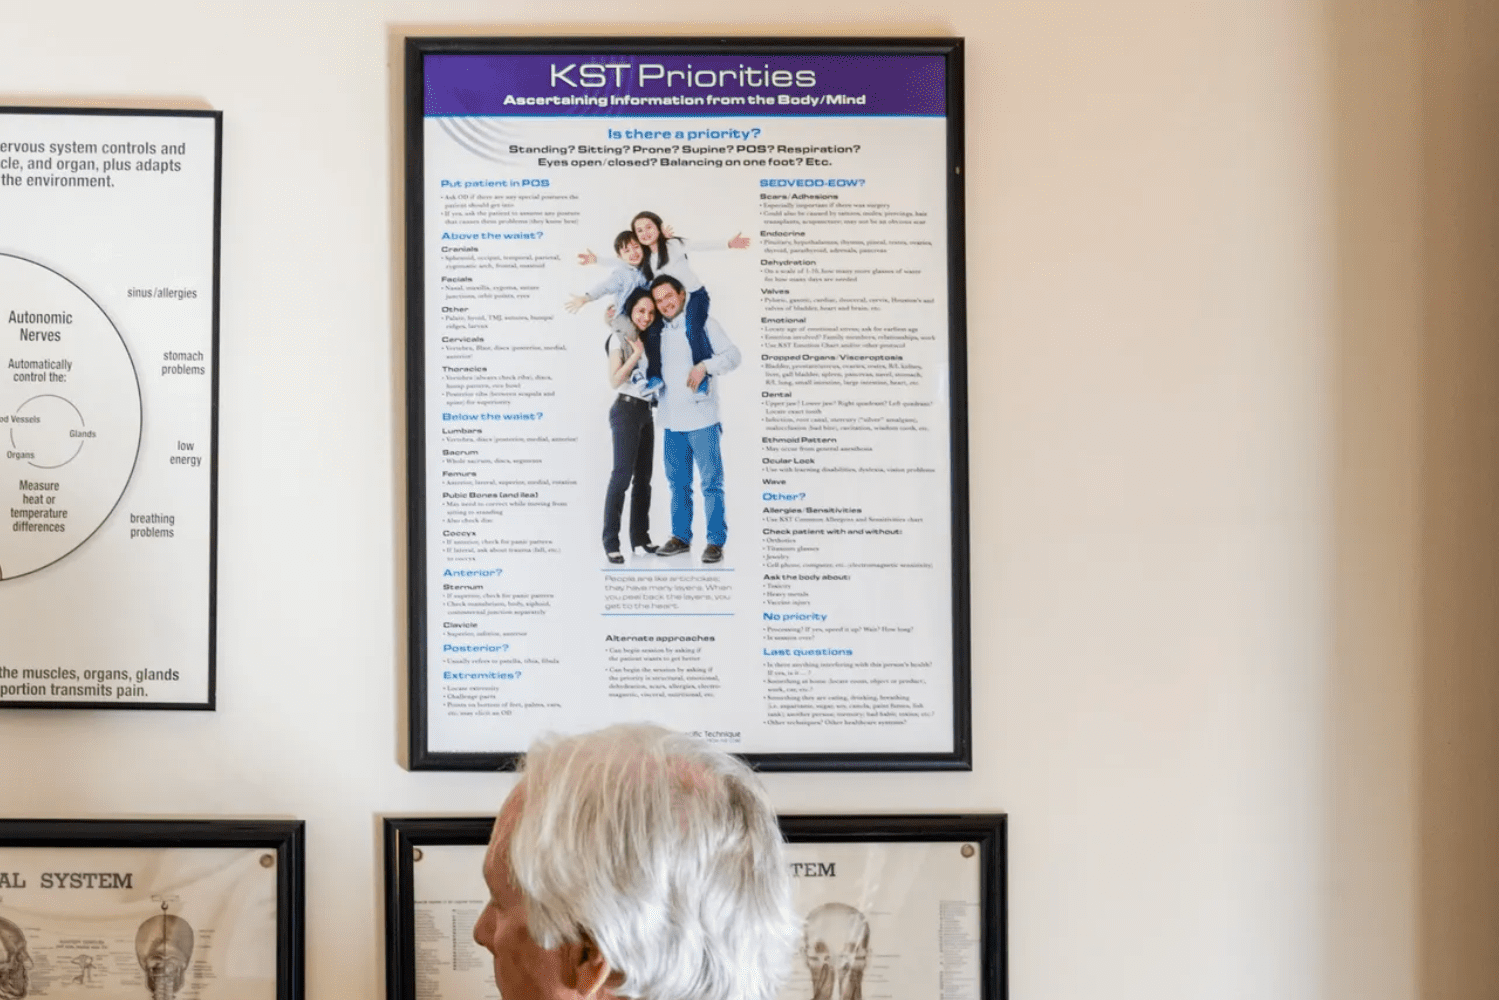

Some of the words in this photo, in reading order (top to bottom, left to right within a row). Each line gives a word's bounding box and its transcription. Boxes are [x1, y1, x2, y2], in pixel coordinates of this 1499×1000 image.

[550, 63, 630, 87] KST
[639, 63, 815, 86] Priorities
[503, 94, 607, 106] Ascertaining
[610, 94, 703, 104] Information
[706, 94, 744, 104] from
[748, 94, 774, 104] the
[778, 94, 865, 106] Body/Mind
[608, 128, 621, 138] Is
[625, 128, 670, 138] there
[675, 131, 683, 139] a
[688, 127, 760, 140] priority?
[50, 141, 96, 155] system
[102, 141, 155, 154] controls
[161, 142, 185, 154] and
[508, 145, 574, 154] Standing?
[578, 145, 629, 154] Sitting?
[632, 145, 678, 154] Prone?
[682, 145, 733, 154] Supine?
[736, 144, 774, 153] POS?
[777, 144, 860, 154] Respiration?
[28, 157, 51, 169] and
[56, 160, 98, 172] organ,
[103, 158, 130, 173] plus
[136, 158, 180, 173] adapts
[538, 158, 568, 167] Eyes
[571, 158, 656, 167] open/closed?
[660, 158, 722, 167] Balancing
[725, 159, 740, 167] on
[743, 159, 765, 167] one
[768, 157, 802, 166] foot?
[806, 157, 831, 166] Etc.
[1, 173, 21, 186] the
[26, 173, 114, 186] environment.
[440, 179, 460, 188] Put
[464, 180, 506, 189] patient
[522, 179, 549, 188] POS
[441, 232, 478, 240] Above
[481, 232, 500, 240] the
[504, 231, 543, 240] waist?
[760, 259, 816, 267] Dehydration
[127, 287, 197, 300] sinus/allergies
[8, 310, 72, 323] Autonomic
[20, 328, 60, 341] Nerves
[163, 351, 203, 361] stomach
[8, 358, 72, 373] Automatically
[161, 364, 204, 375] problems
[13, 371, 45, 381] control
[49, 372, 67, 382] the:
[442, 412, 478, 421] Below
[503, 412, 542, 421] waist?
[69, 429, 96, 437] Glands
[177, 440, 194, 450] low
[6, 450, 34, 460] Organs
[169, 455, 201, 466] energy
[19, 479, 59, 490] Measure
[22, 493, 42, 504] heat
[46, 496, 55, 504] or
[762, 492, 805, 501] Other?
[10, 508, 67, 520] temperature
[130, 513, 174, 526] breathing
[12, 521, 64, 532] differences
[130, 524, 174, 538] problems
[443, 568, 502, 577] Anterior?
[762, 612, 780, 621] No
[782, 613, 826, 622] priority
[605, 634, 653, 642] Alternate
[656, 635, 714, 643] approaches
[443, 644, 508, 653] Posterior?
[763, 648, 790, 656] Last
[793, 648, 852, 657] questions
[22, 666, 78, 680] muscles,
[84, 669, 130, 682] organs,
[136, 668, 178, 683] glands
[443, 671, 521, 680] Extremities?
[0, 682, 45, 697] portion
[50, 683, 111, 695] transmits
[117, 687, 147, 698] pain.
[41, 872, 132, 889] SYSTEM
